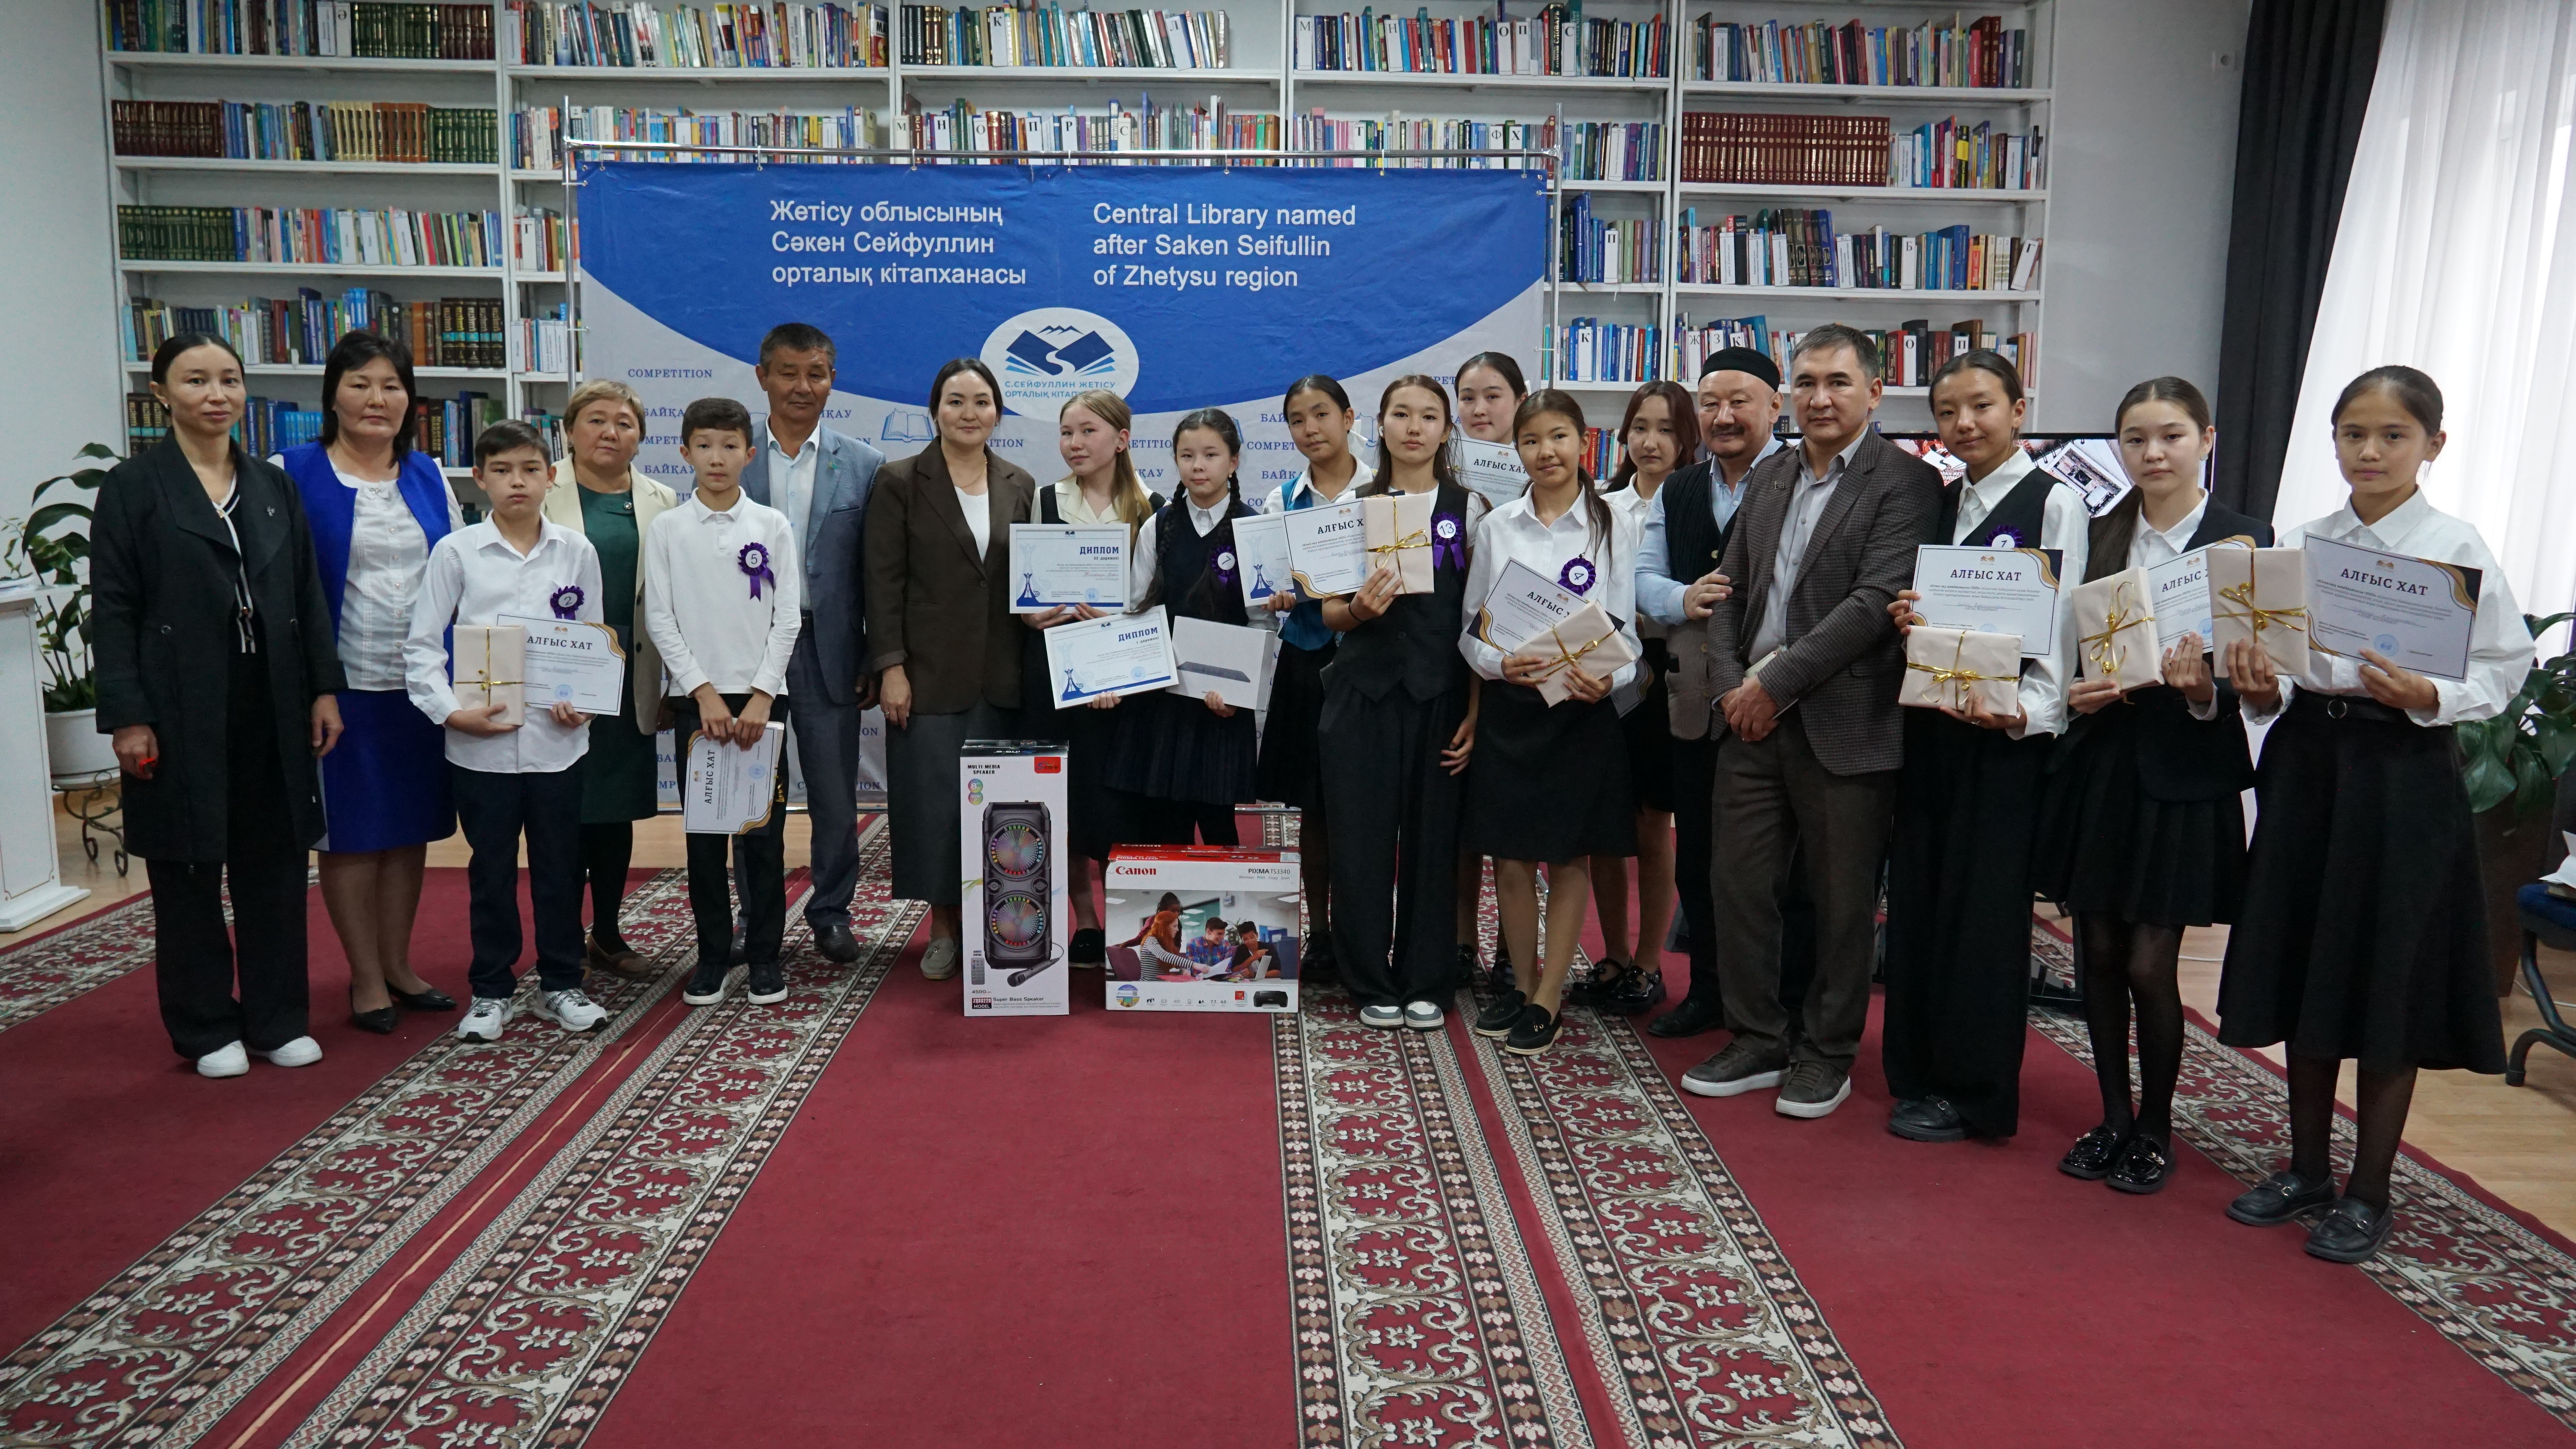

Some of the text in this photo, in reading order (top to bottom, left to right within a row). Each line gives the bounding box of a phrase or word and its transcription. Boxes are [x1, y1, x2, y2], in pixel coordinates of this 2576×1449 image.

[993, 16, 1002, 27] К
[1170, 20, 1180, 31] Л
[1299, 22, 1311, 32] М
[1388, 24, 1397, 34] Н
[1499, 27, 1508, 37] О
[1519, 26, 1527, 35] П
[1565, 27, 1574, 36] С
[897, 123, 906, 131] М
[937, 121, 947, 130] Н
[976, 124, 985, 135] О
[1029, 121, 1038, 131] П
[1065, 121, 1073, 131] Р
[1120, 124, 1128, 136] С
[1356, 127, 1363, 137] Т
[1492, 130, 1502, 140] Ф
[1511, 130, 1520, 140] Х
[771, 201, 1002, 227] Жетісу облысының
[1094, 203, 1356, 230] Central Library named
[1607, 234, 1616, 243] П
[772, 231, 994, 257] Сәкен Сейфуллин
[1094, 234, 1330, 257] after Saken Seifullin
[1906, 241, 1913, 252] Б
[2026, 243, 2035, 253] Г
[772, 263, 1025, 288] орталық кітапханасы
[1094, 264, 1297, 291] of Zhetysu region
[1581, 332, 1590, 343] К
[1689, 335, 1701, 345] Ж
[1713, 334, 1720, 344] З
[1905, 340, 1915, 349] О
[1958, 340, 1966, 349] П
[628, 369, 713, 378] COMPETITION
[1005, 380, 1075, 388] С.СЕЙФУЛЛИН
[1005, 391, 1049, 399] ОРТАЛЫҚ
[644, 409, 684, 418] БАЙҚА
[819, 409, 852, 418] ЙҚАУ
[1261, 413, 1286, 423] БАЙ
[1130, 440, 1172, 449] ETITIO
[1247, 442, 1298, 450] COMPET
[1473, 459, 1507, 471] АЛҒЫС
[1318, 521, 1354, 534] АЛҒЫС
[1440, 523, 1455, 536] 13
[1080, 546, 1119, 555] ДИПЛОМ
[750, 554, 757, 564] 5
[1574, 572, 1584, 581] 4
[1950, 569, 2021, 581] АЛҒЫС ХАТ
[2162, 571, 2201, 592] АЛҒЫС
[2341, 568, 2428, 596] АЛҒЫС ХАТ
[564, 596, 573, 606] 2
[1527, 591, 1564, 615] АЛҒЫС
[1118, 627, 1158, 642] ДИПЛОМ
[527, 636, 593, 650] АЛҒЫС ХАТ
[704, 749, 716, 804] АЛҒЫС ХАТ
[1115, 866, 1157, 875] Canon
